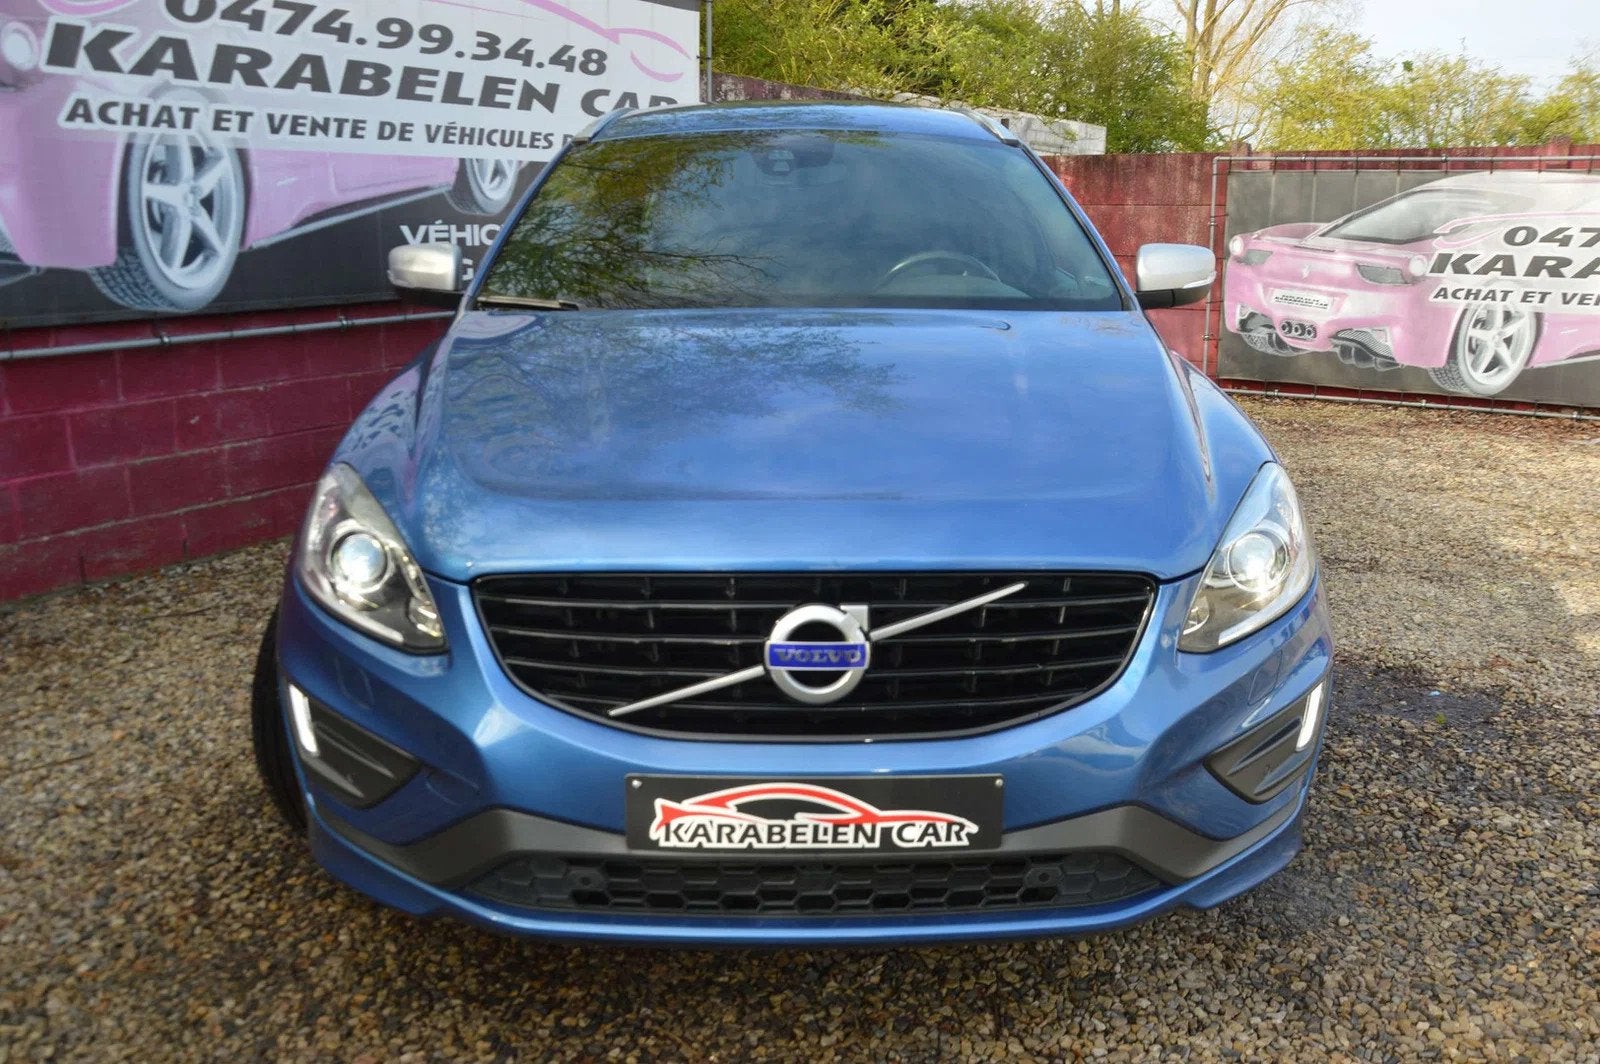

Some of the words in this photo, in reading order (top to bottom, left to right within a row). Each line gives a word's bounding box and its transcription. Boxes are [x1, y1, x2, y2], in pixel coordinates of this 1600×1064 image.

[46, 22, 560, 114] KARABELEN
[65, 98, 199, 129] ACHAT
[212, 109, 253, 133] ET
[267, 113, 367, 139] VENTE
[377, 121, 414, 142] DE
[425, 121, 555, 150] VÉHICULES
[1433, 287, 1513, 302] ACHAT
[1520, 290, 1552, 304] ET
[774, 647, 863, 664] VOLVO
[663, 822, 878, 845] KARABELEN
[896, 822, 966, 845] CAR
